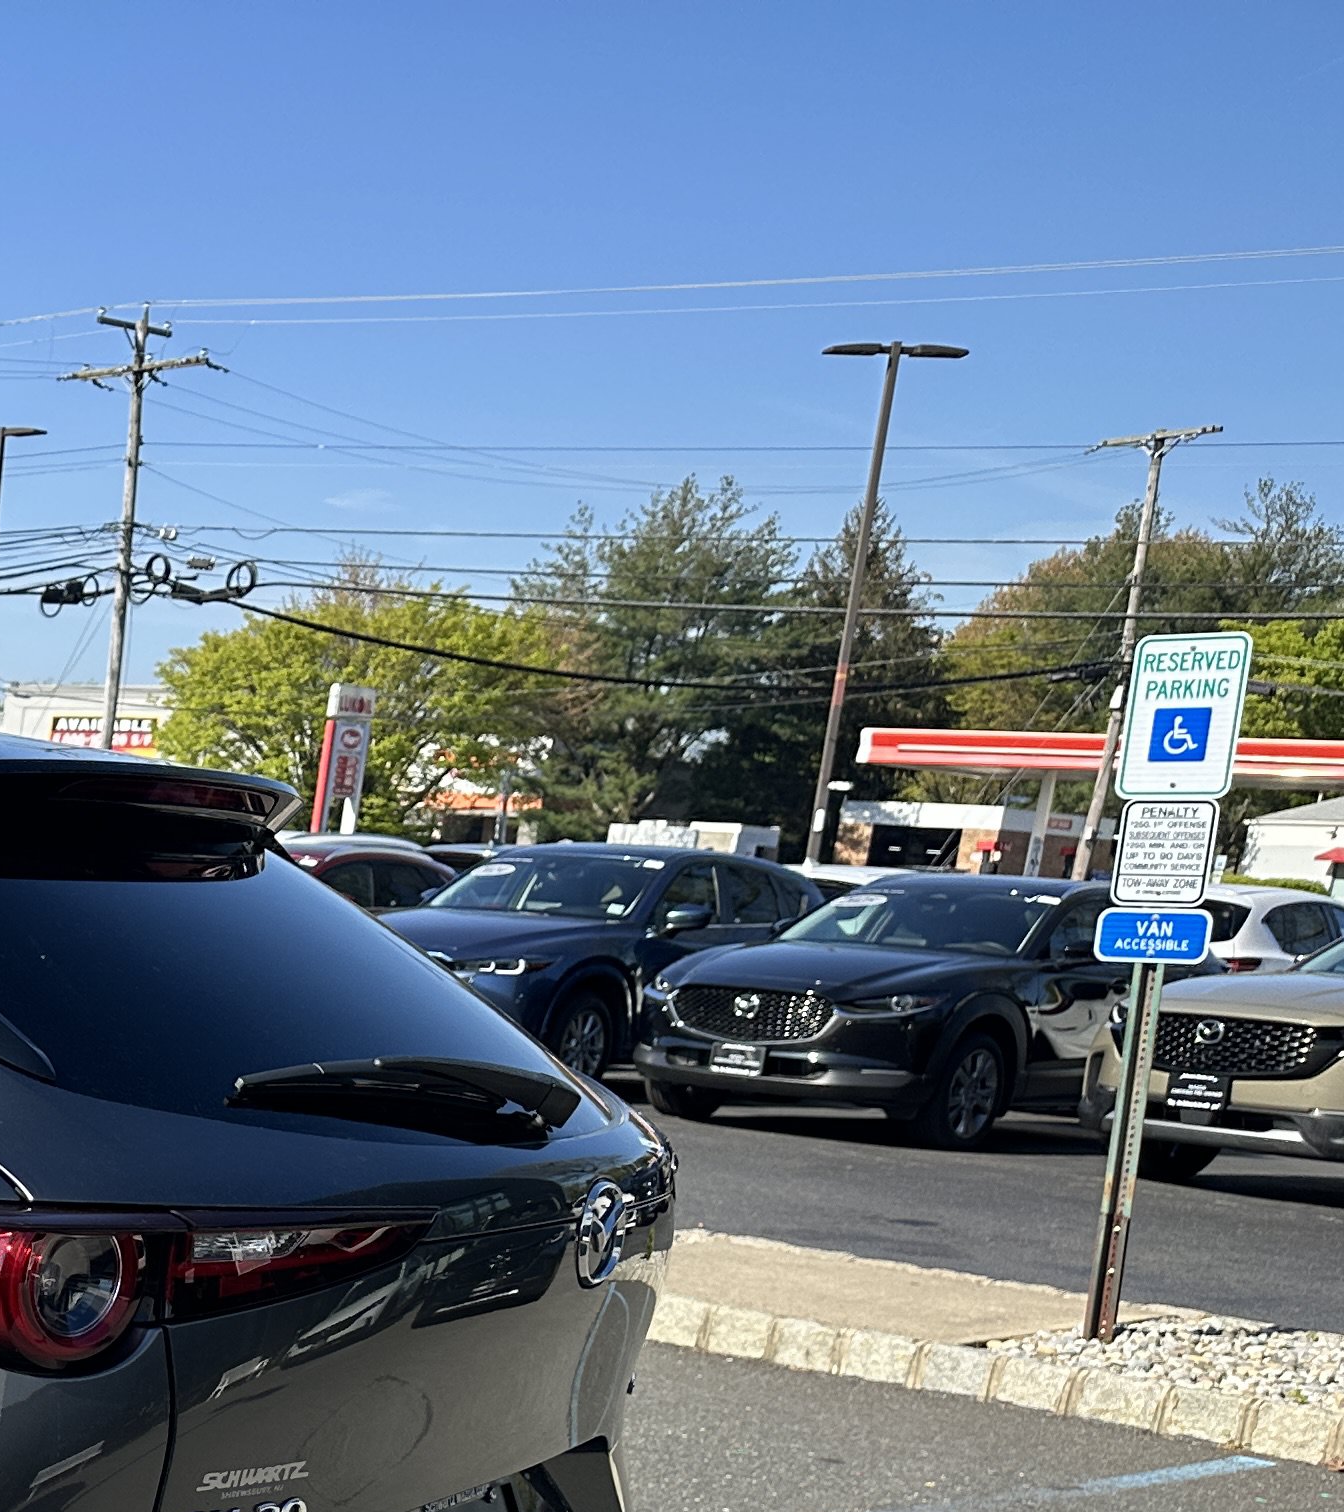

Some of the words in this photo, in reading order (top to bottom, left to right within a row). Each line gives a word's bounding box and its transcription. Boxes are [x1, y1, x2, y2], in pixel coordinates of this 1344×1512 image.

[1143, 650, 1241, 673] RESERVED
[1145, 679, 1230, 700] PARKING
[1141, 807, 1200, 818] PENALTY
[1167, 821, 1207, 829] OFFENSE
[1129, 831, 1171, 840] SUBSEQUENT
[1173, 831, 1206, 840] OFFENSES
[1126, 852, 1139, 860] UP
[1143, 852, 1155, 860] TO
[1160, 852, 1173, 860] 90
[1177, 852, 1202, 861] DAYS
[1171, 863, 1200, 871] SERVICE
[1122, 877, 1170, 888] TOW-AWAY
[1173, 879, 1198, 889] ZONE
[1136, 921, 1174, 937] VAN
[1114, 938, 1190, 952] ACCESSIBLE
[196, 1460, 310, 1492] SCHWARTZ
